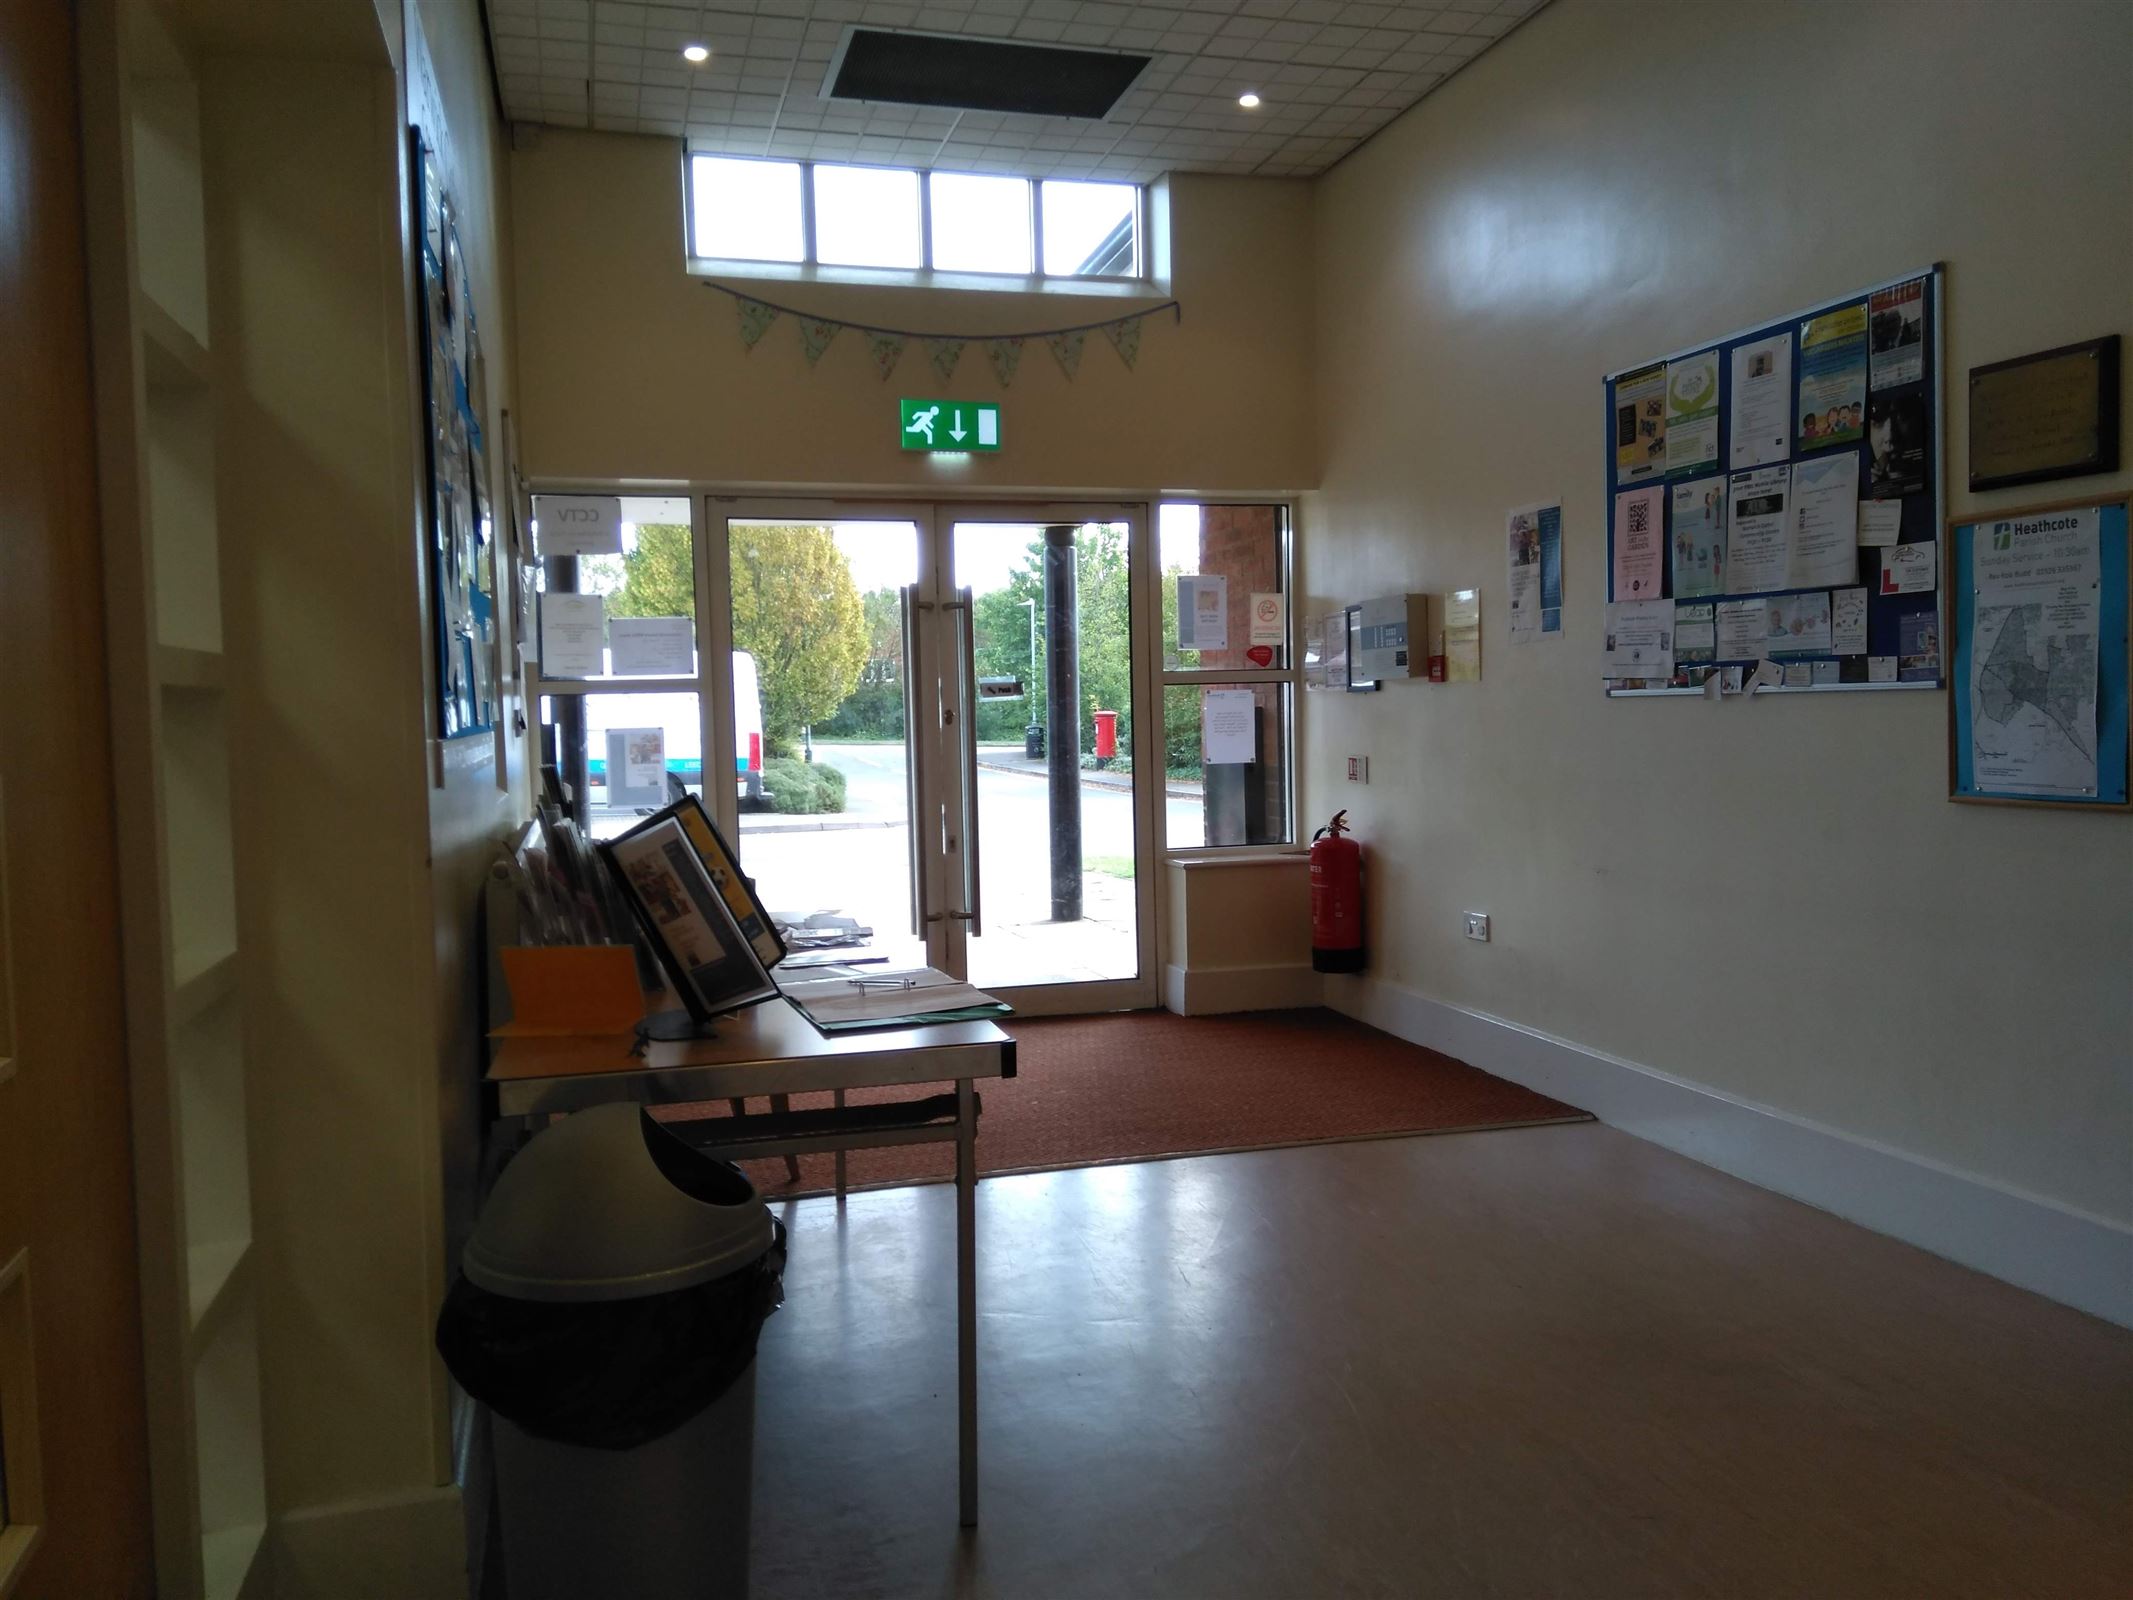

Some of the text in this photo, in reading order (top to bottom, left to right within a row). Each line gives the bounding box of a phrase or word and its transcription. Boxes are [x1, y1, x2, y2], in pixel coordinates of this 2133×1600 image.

[2014, 517, 2078, 535] Heathcote
[2014, 532, 2078, 547] Parish Church
[1980, 555, 2010, 568] Sunday
[2012, 551, 2043, 563] Service
